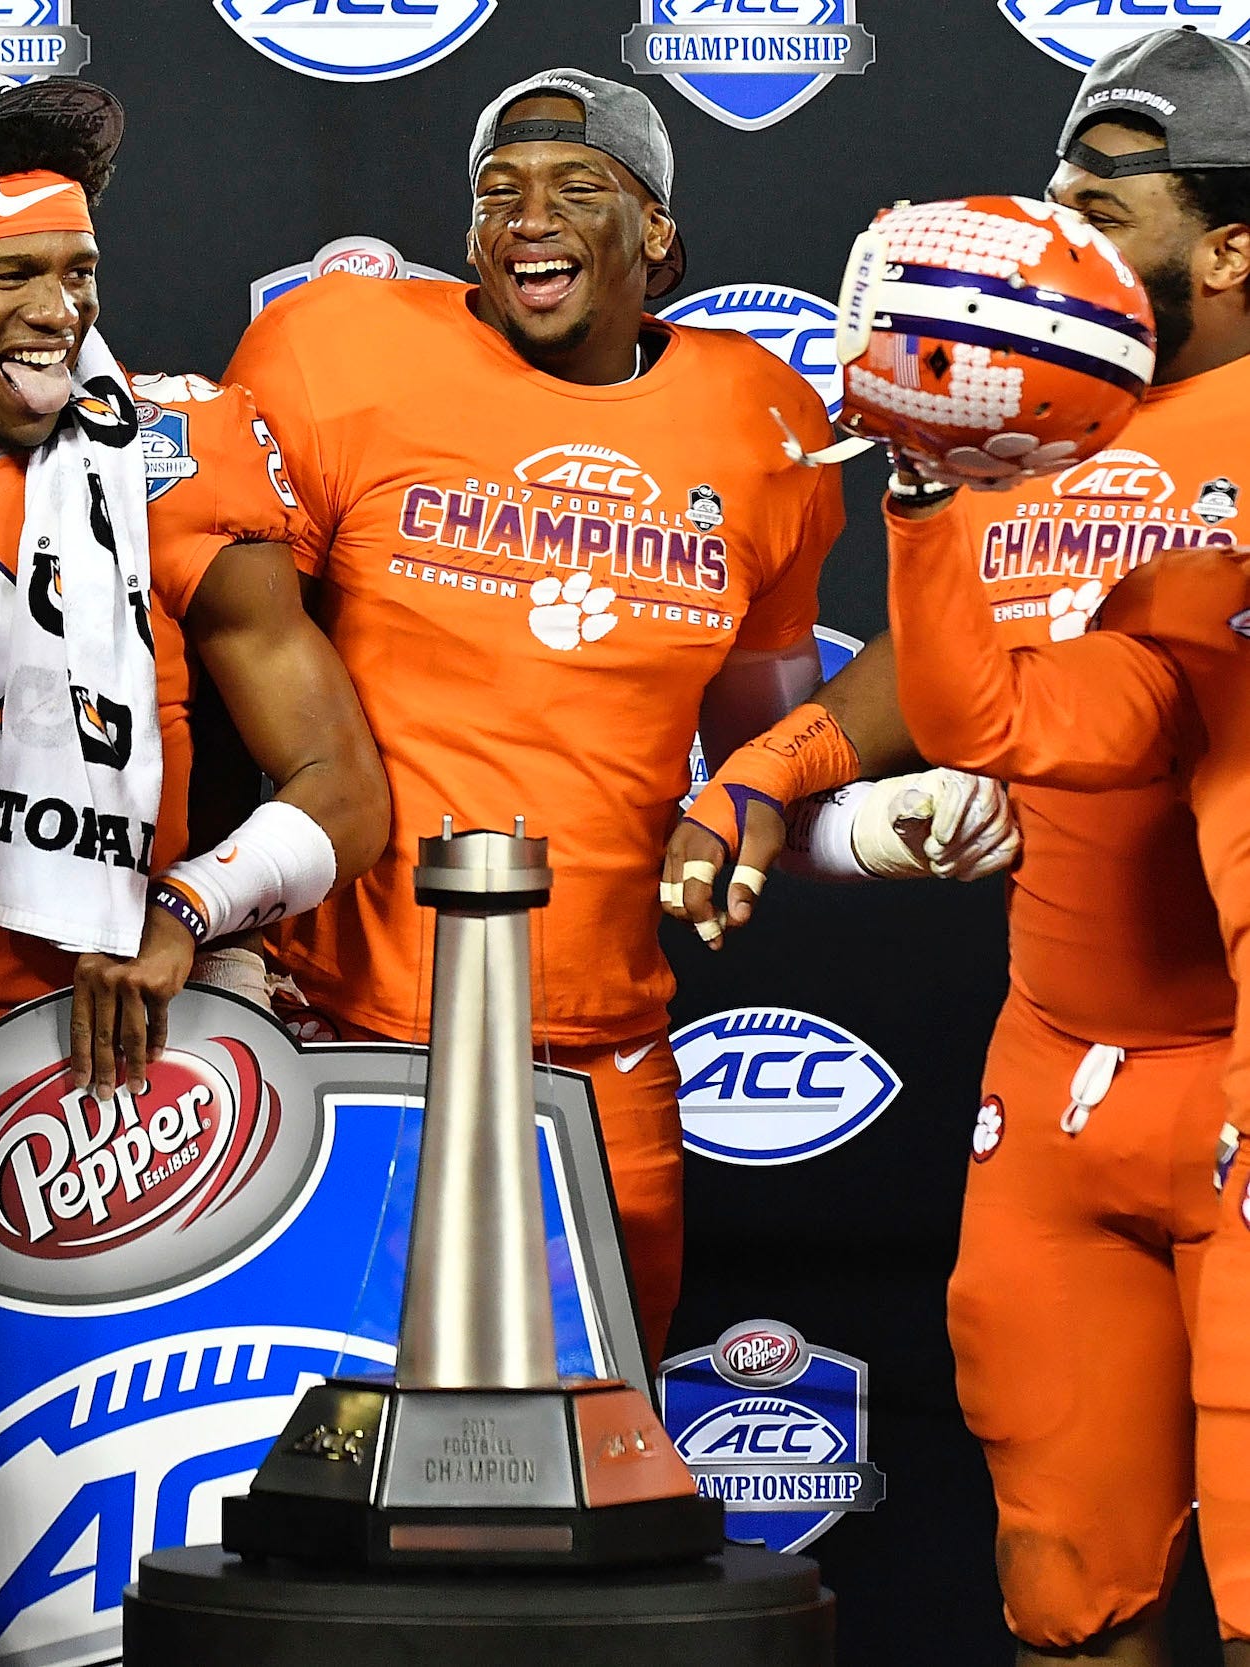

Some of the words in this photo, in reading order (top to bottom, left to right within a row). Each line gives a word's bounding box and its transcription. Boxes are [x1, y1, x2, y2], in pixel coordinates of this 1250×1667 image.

[649, 36, 848, 61] CHAMPIONSHIP
[1111, 88, 1178, 116] CHAMPIONS
[538, 461, 642, 496] ACC
[1068, 468, 1160, 495] ACC
[466, 477, 534, 504] 2017
[552, 495, 685, 528] FOOTBALL
[1016, 503, 1064, 518] 2017
[1075, 503, 1191, 522] FOOTBALL
[398, 484, 729, 595] CHAMPIONS
[388, 559, 518, 599] CLEMSON
[630, 602, 734, 631] TIGERS
[156, 890, 177, 908] IN
[181, 905, 205, 937] ALL
[676, 1050, 858, 1100] ACC
[731, 1341, 786, 1371] Pepper
[751, 1337, 773, 1355] Dr
[701, 1423, 821, 1454] ACC
[424, 1457, 537, 1485] CHAMPION
